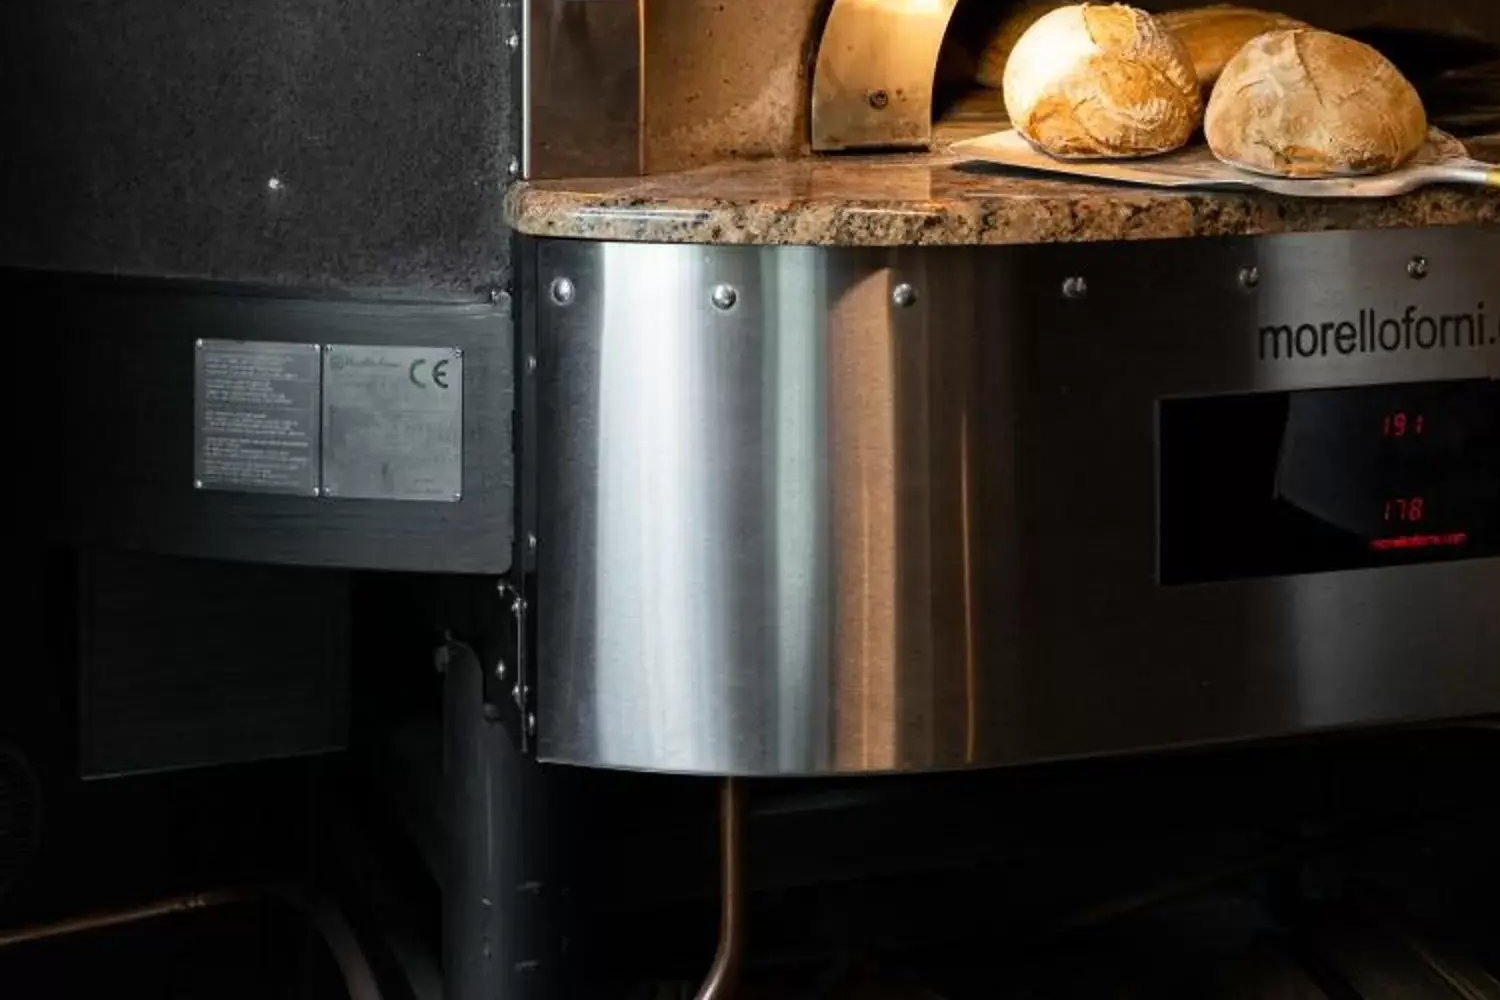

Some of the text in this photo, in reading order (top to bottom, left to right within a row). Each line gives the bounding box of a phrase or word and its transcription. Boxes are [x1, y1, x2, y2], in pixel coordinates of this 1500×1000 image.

[408, 358, 449, 389] CE
[1383, 412, 1424, 436] 191
[1384, 496, 1424, 521] 178
